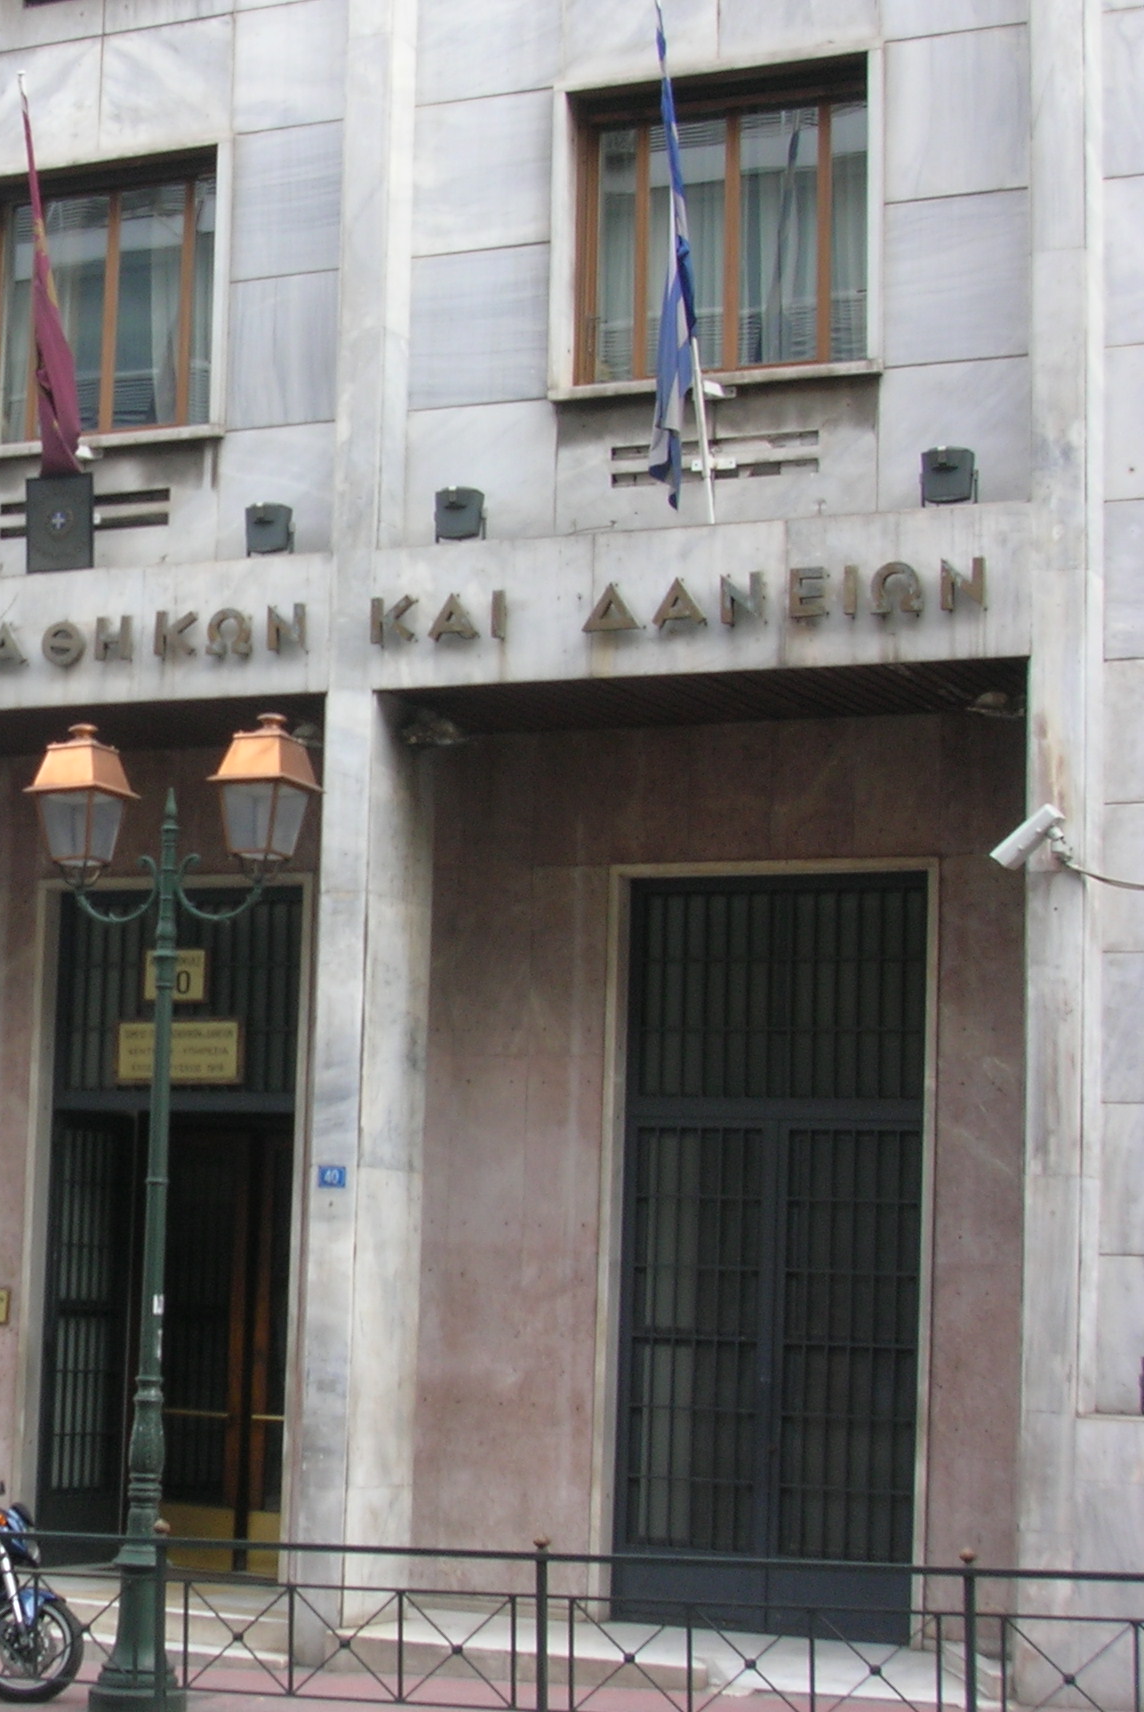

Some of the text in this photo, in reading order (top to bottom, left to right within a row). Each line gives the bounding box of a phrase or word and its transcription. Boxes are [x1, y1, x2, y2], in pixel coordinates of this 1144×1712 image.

[369, 589, 508, 646] ΚΑΙ
[581, 556, 988, 633] ΔΑΝΕΙΩΝ
[325, 1169, 340, 1184] 40
